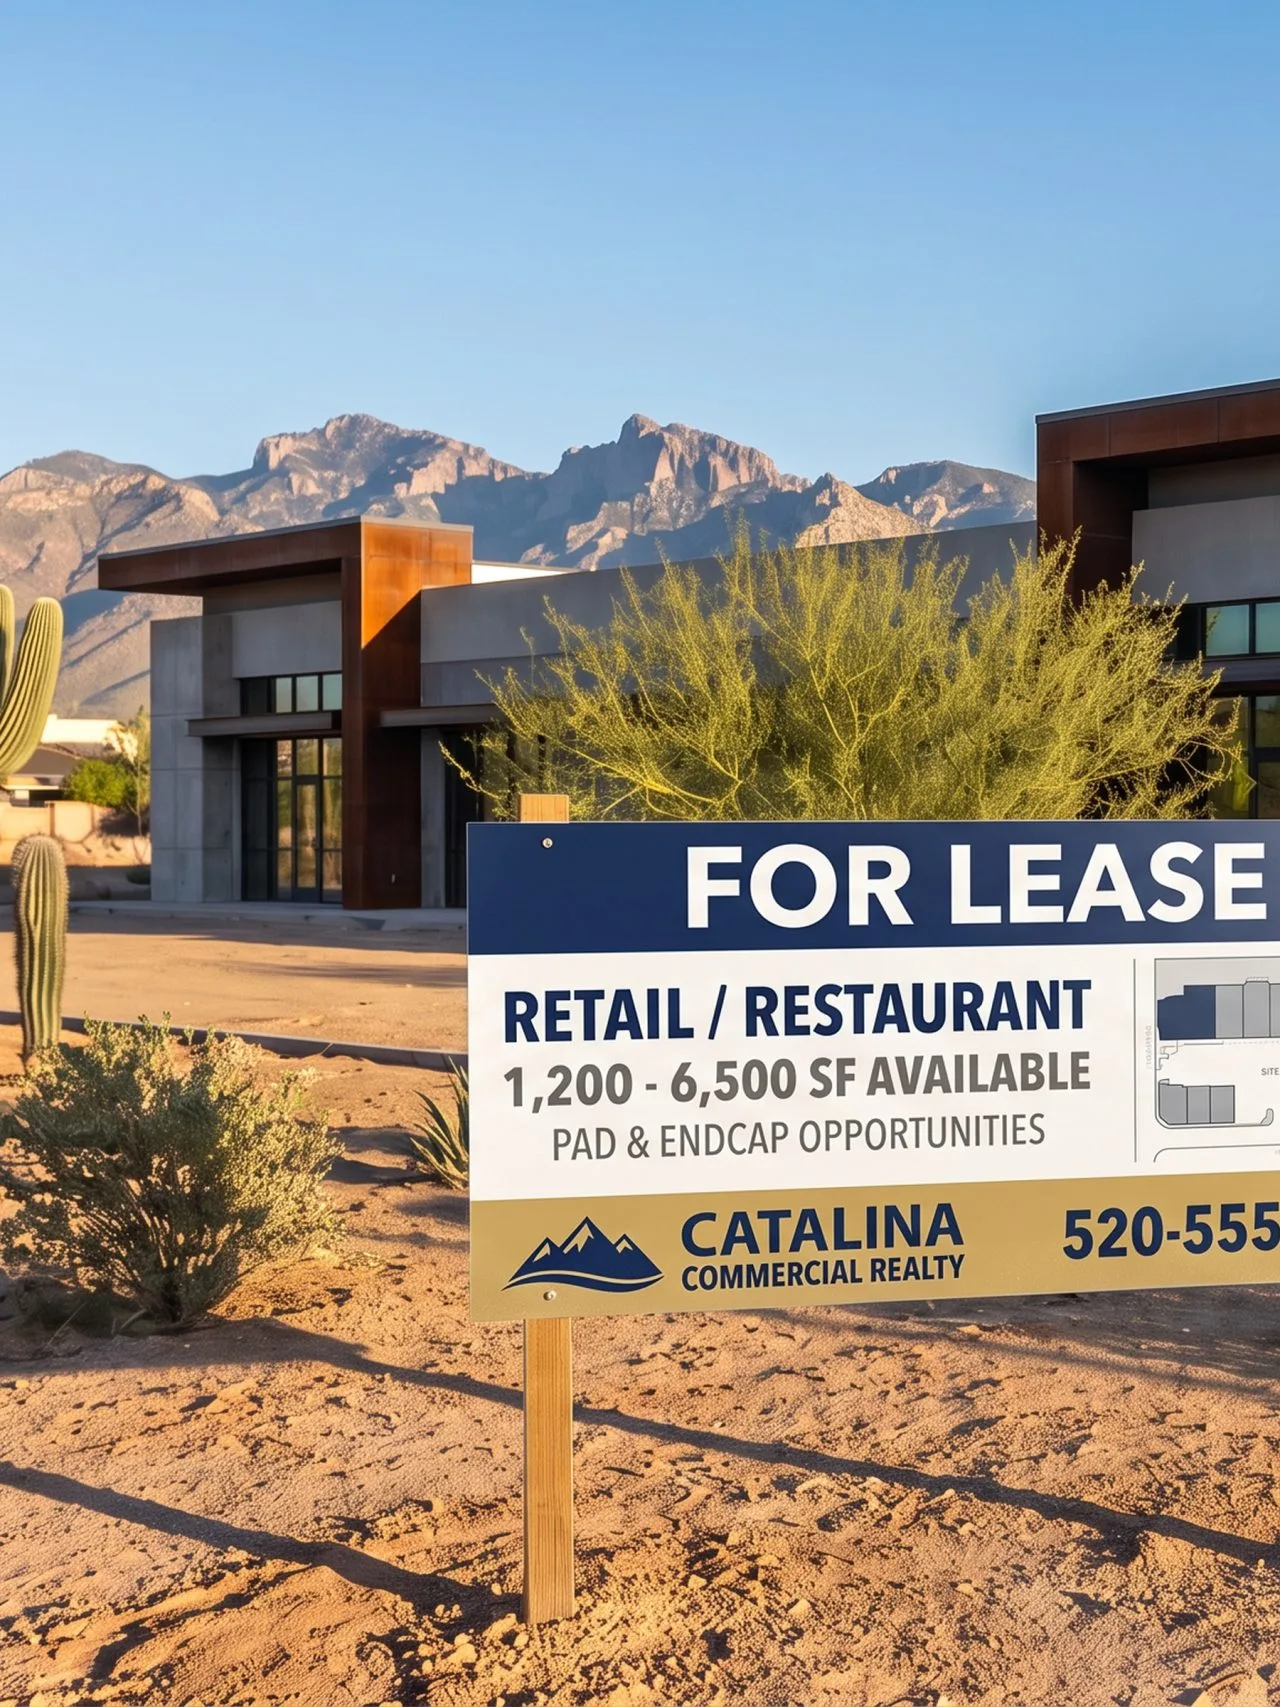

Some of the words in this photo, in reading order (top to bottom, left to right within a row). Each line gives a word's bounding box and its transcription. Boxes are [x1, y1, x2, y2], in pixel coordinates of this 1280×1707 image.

[687, 843, 914, 928] FOR
[950, 841, 1267, 924] LEASE
[503, 987, 694, 1042] RETAIL
[708, 984, 727, 1039] /
[746, 979, 1092, 1036] RESTAURANT
[503, 1063, 632, 1113] 1,200
[645, 1082, 657, 1091] -
[670, 1058, 796, 1107] 6,500
[810, 1055, 855, 1098] SF
[866, 1051, 1091, 1095] AVAILABLE
[1261, 1067, 1279, 1076] SITE
[553, 1126, 617, 1160] PAD
[626, 1125, 650, 1157] &
[661, 1121, 789, 1156] ENDCAP
[799, 1113, 1046, 1151] OPPORTUNITIES
[681, 1203, 964, 1256] CATALINA
[681, 1258, 864, 1291] COMMERCIAL
[870, 1254, 965, 1282] REALTY
